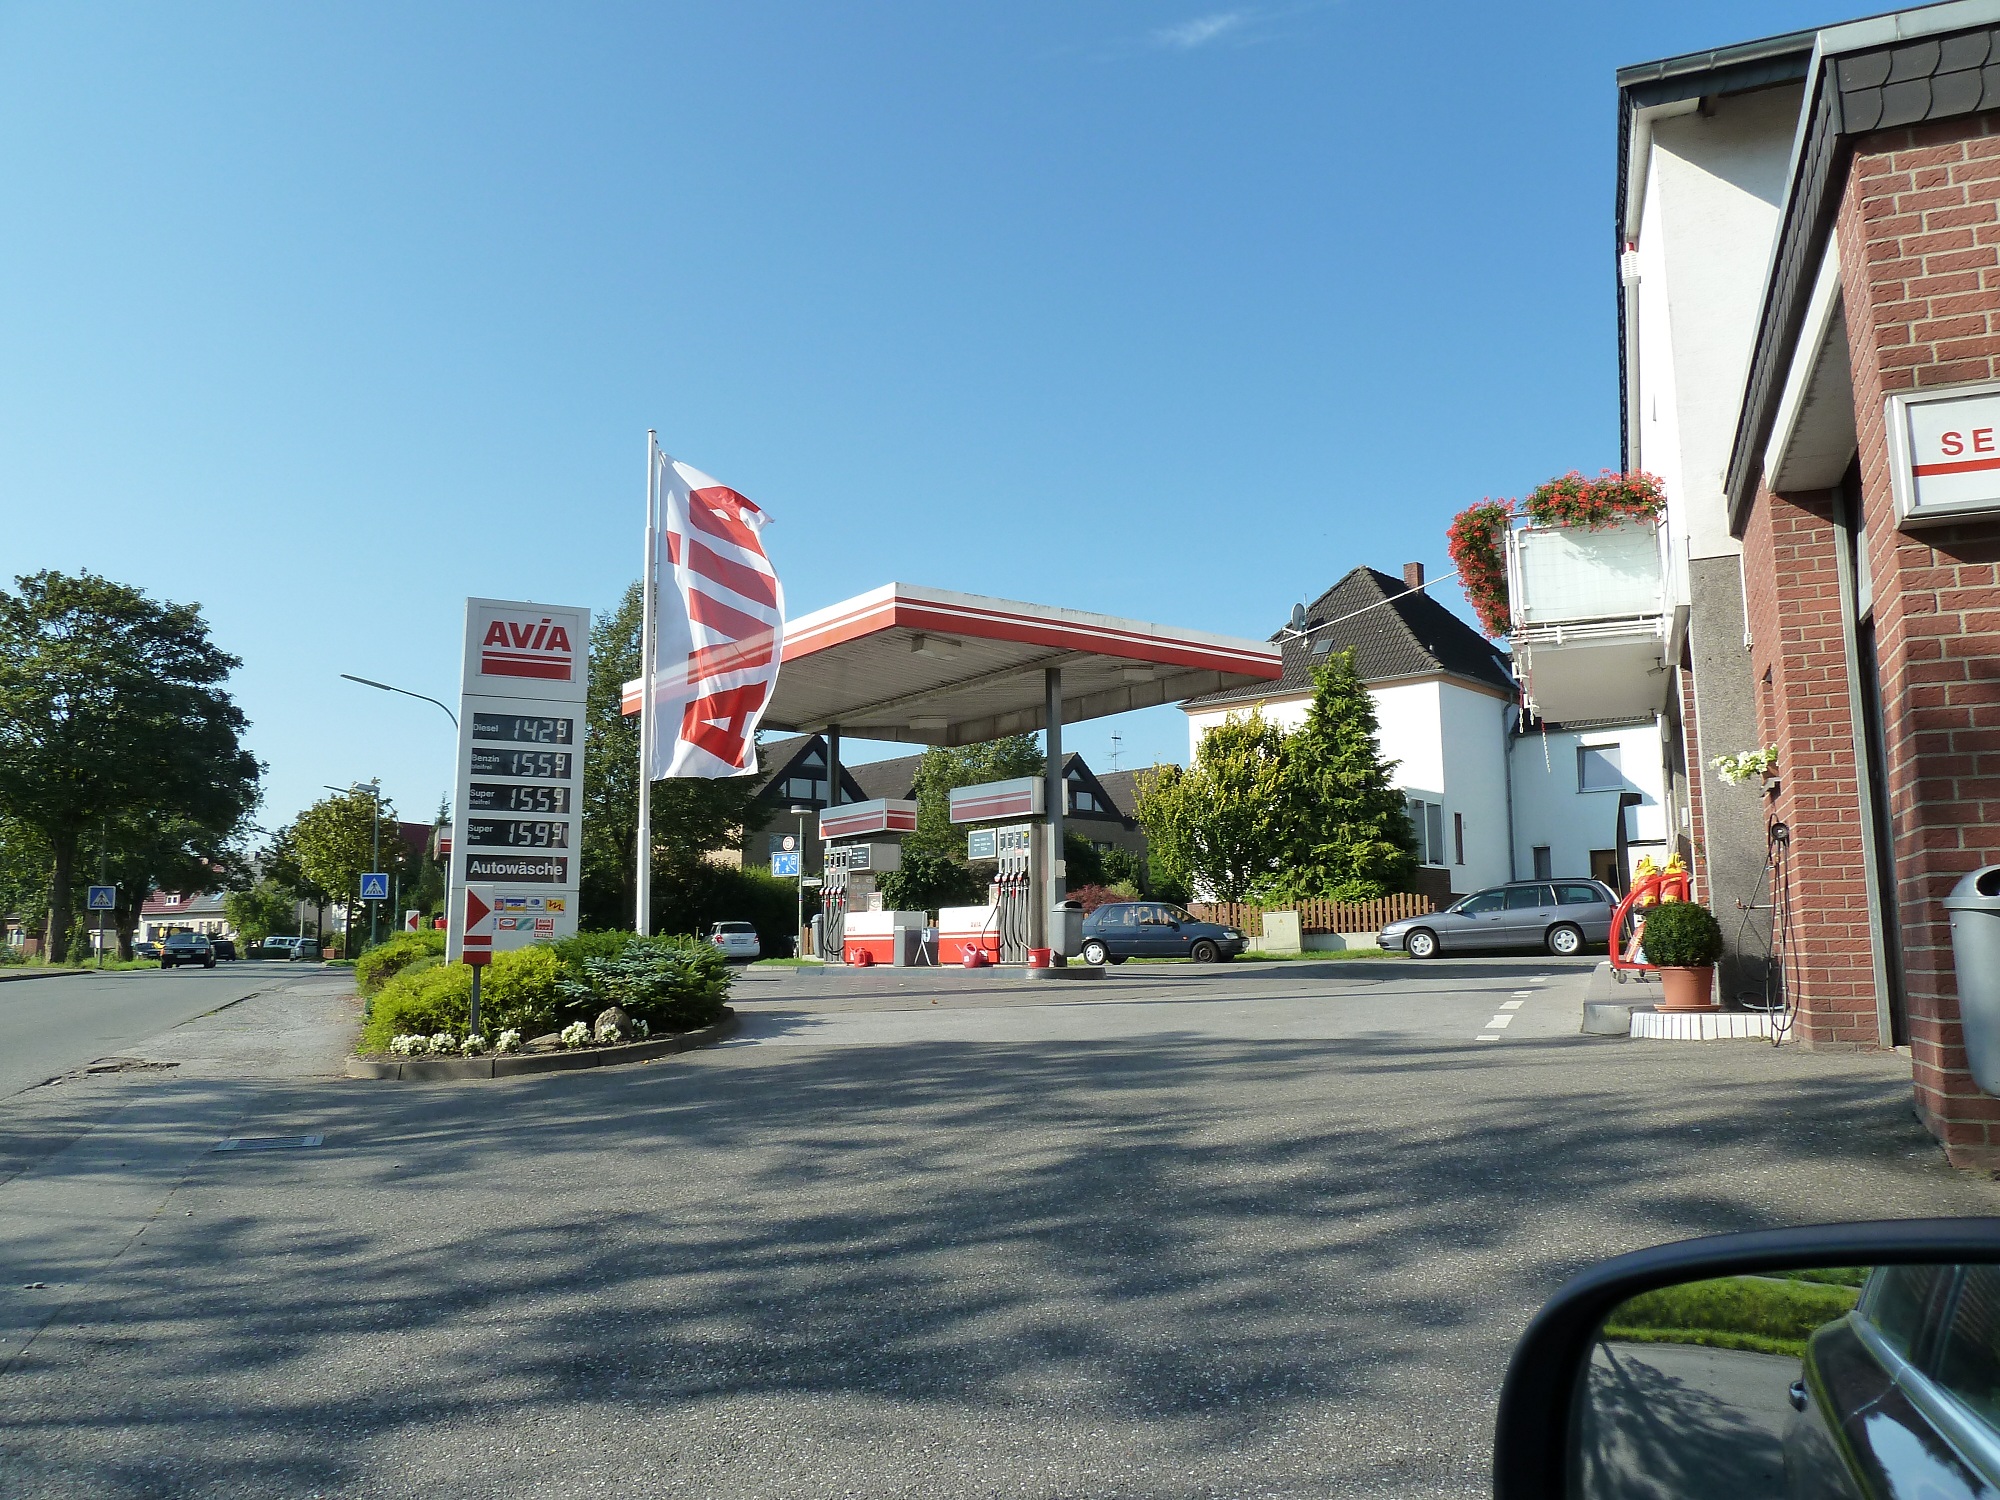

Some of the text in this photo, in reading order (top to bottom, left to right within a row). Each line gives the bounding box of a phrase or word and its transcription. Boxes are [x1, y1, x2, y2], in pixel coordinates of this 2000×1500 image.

[1940, 427, 1996, 456] SE
[473, 719, 567, 743] Diesel 1429
[471, 753, 566, 777] Benzin 1559
[470, 787, 565, 812] Super 1559
[468, 822, 563, 846] Super 1599
[470, 860, 563, 875] Autowäsche
